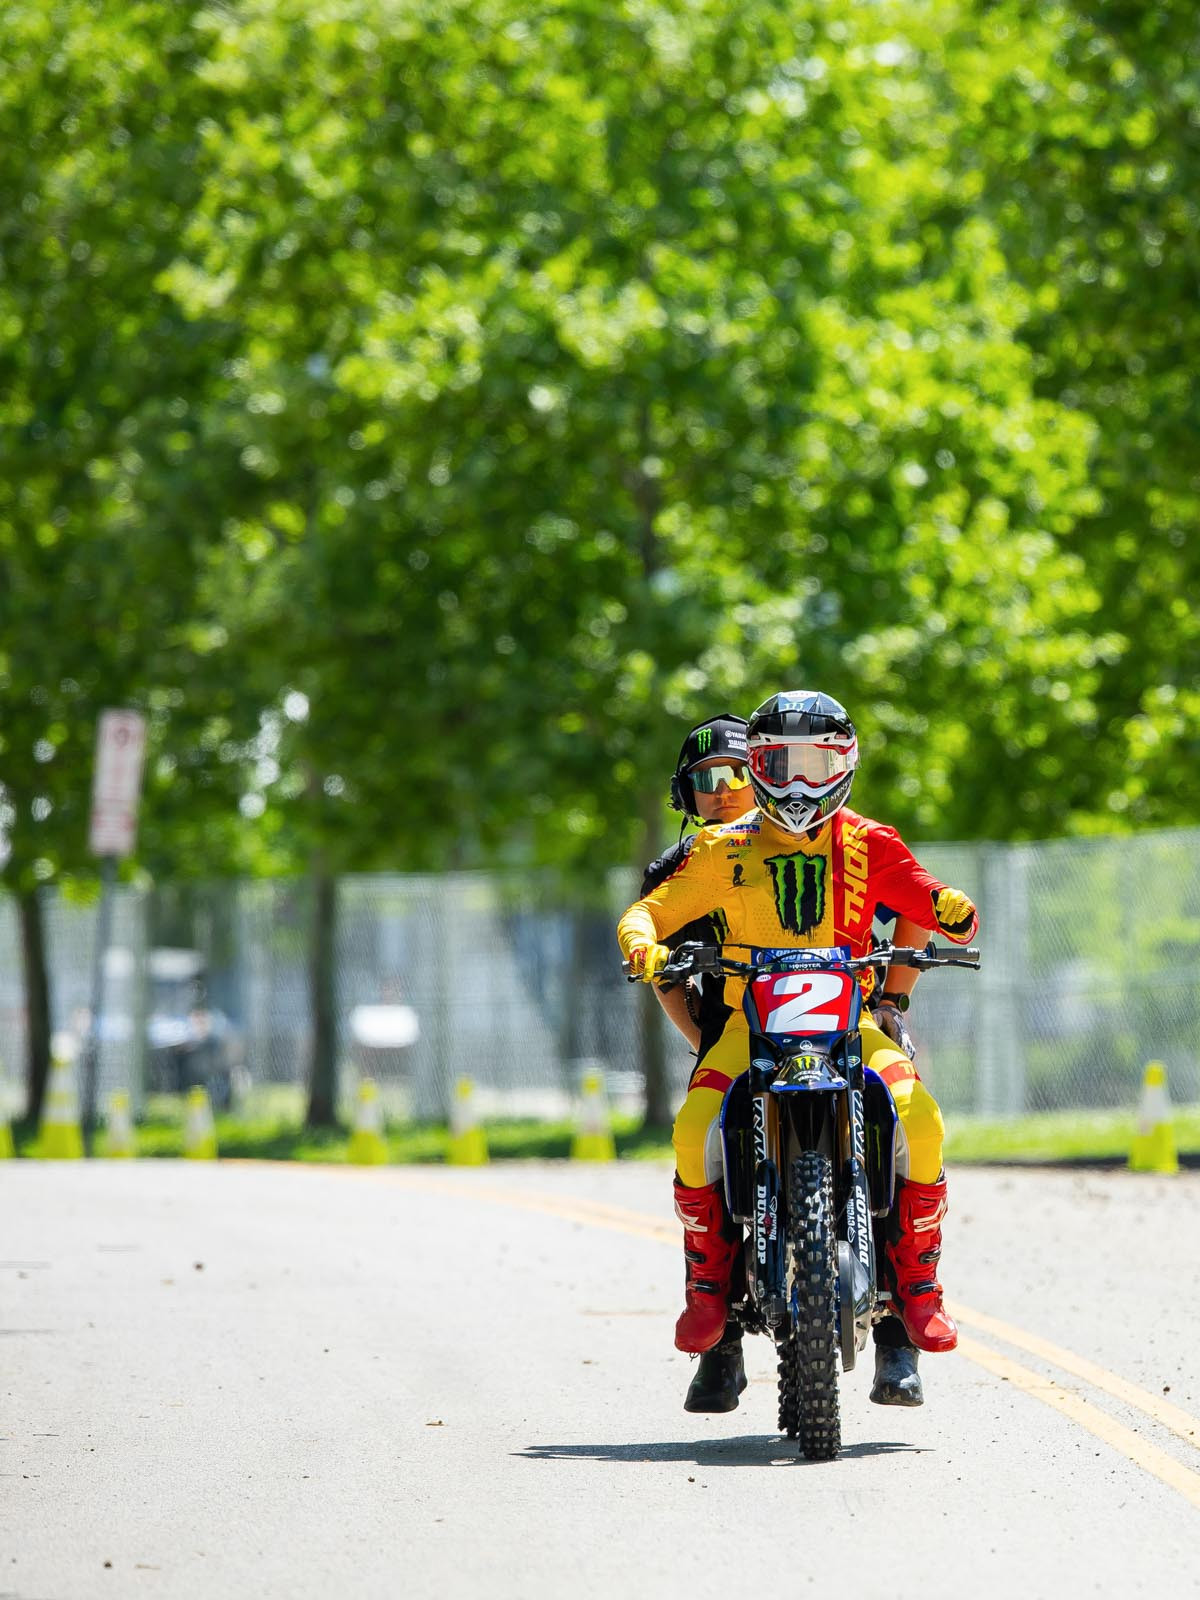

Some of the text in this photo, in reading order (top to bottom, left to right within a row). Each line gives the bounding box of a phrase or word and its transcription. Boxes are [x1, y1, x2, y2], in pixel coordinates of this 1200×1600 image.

[842, 821, 869, 928] THOR
[765, 973, 843, 1033] 2
[757, 1184, 767, 1264] DUNLOP
[856, 1185, 869, 1267] DUNLOP
